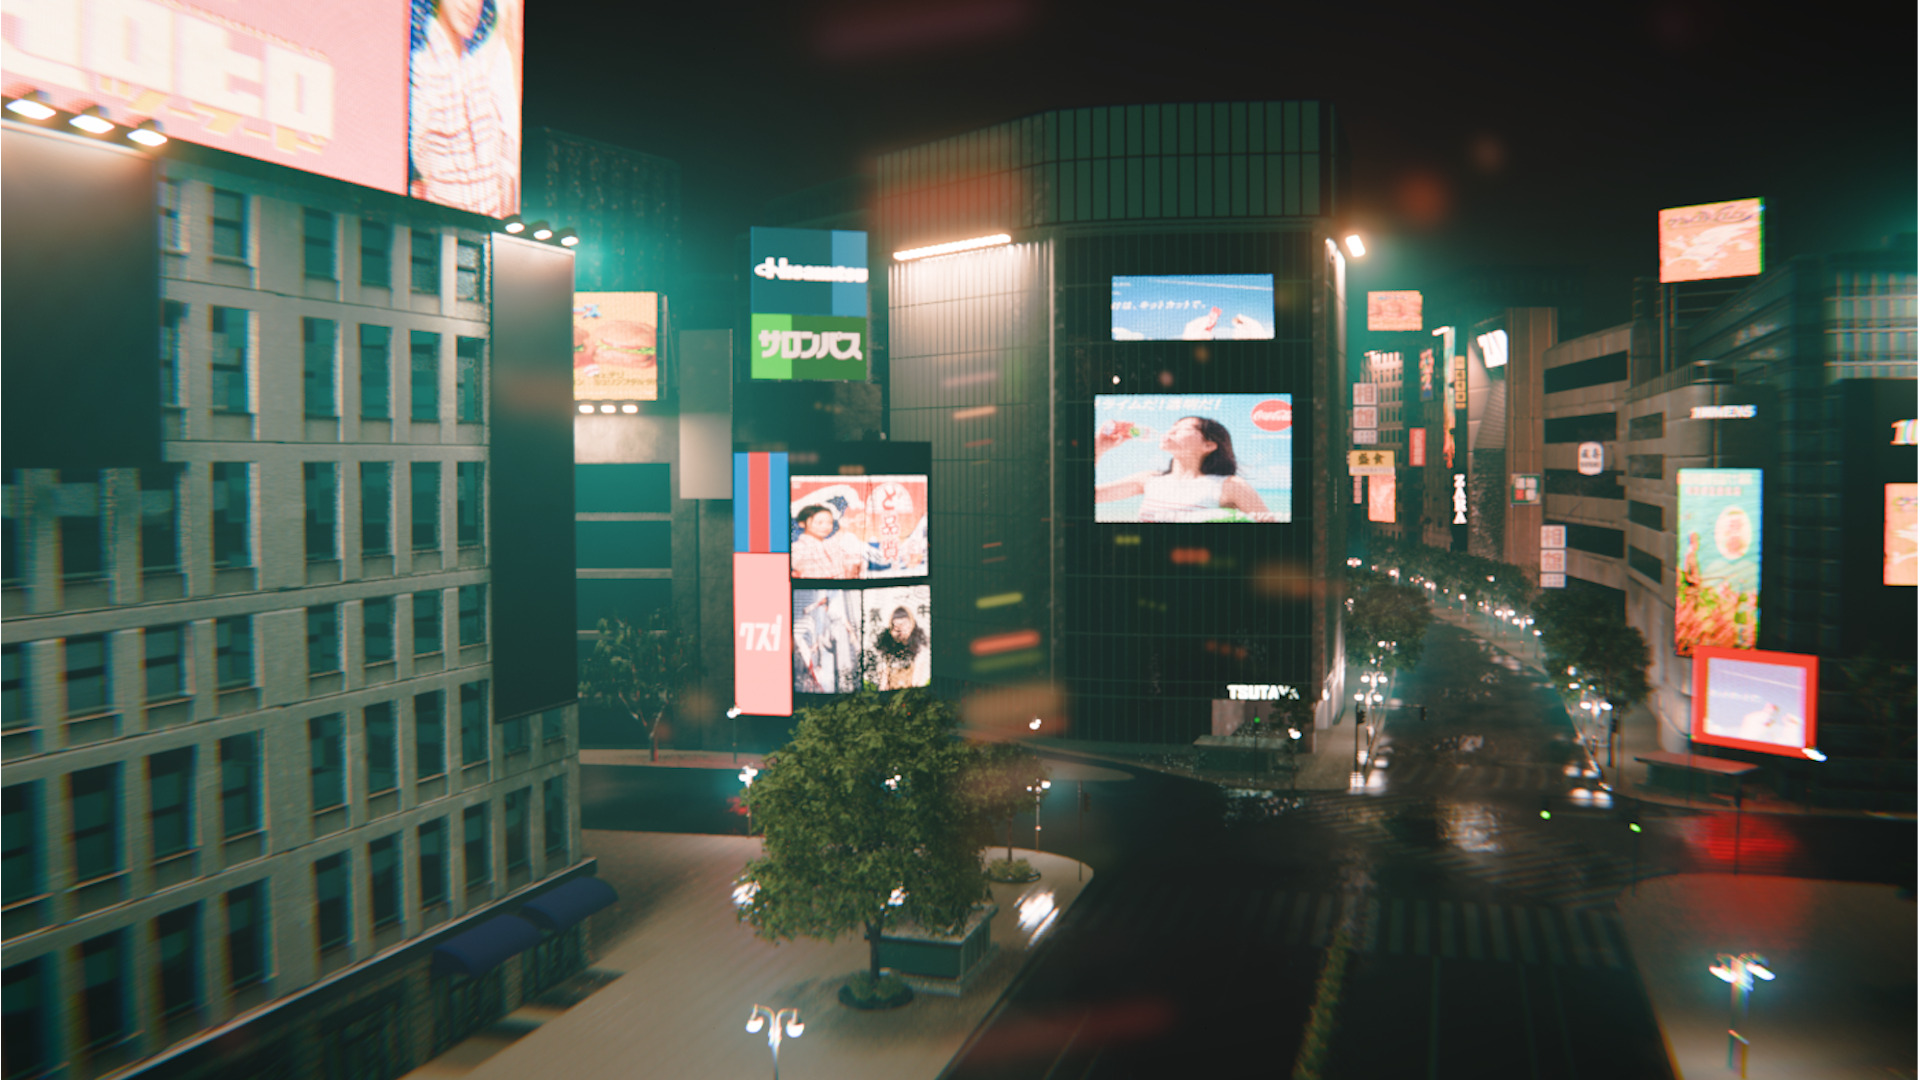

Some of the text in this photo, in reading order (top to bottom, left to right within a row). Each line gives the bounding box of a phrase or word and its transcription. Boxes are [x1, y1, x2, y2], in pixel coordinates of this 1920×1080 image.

[758, 329, 863, 361] サロンパス
[1453, 474, 1467, 524] ZARA
[1226, 684, 1300, 700] TSUTAYA
